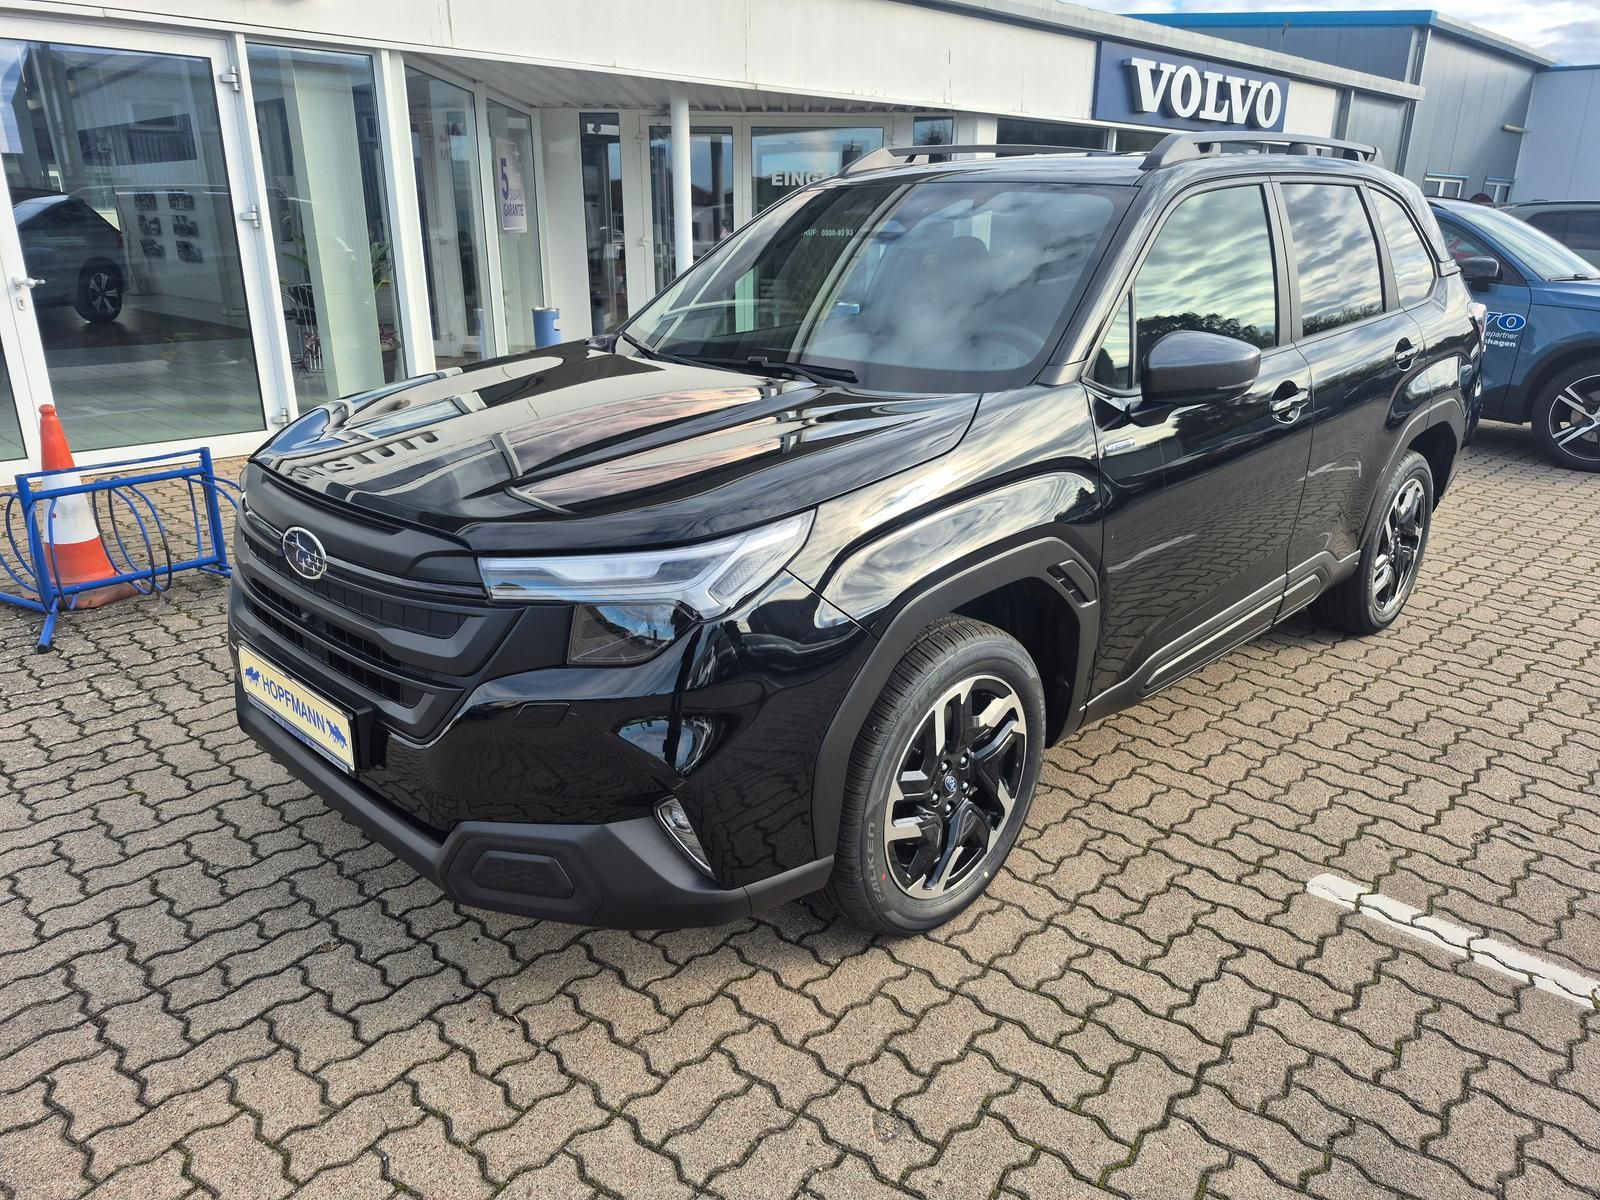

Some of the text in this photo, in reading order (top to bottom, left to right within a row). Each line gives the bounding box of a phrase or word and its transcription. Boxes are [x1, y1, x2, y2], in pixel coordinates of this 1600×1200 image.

[1127, 57, 1282, 129] VOLVO
[500, 157, 510, 200] 5
[771, 171, 828, 187] EING
[503, 203, 525, 217] GARANTIE
[261, 674, 326, 735] HOPFMANN
